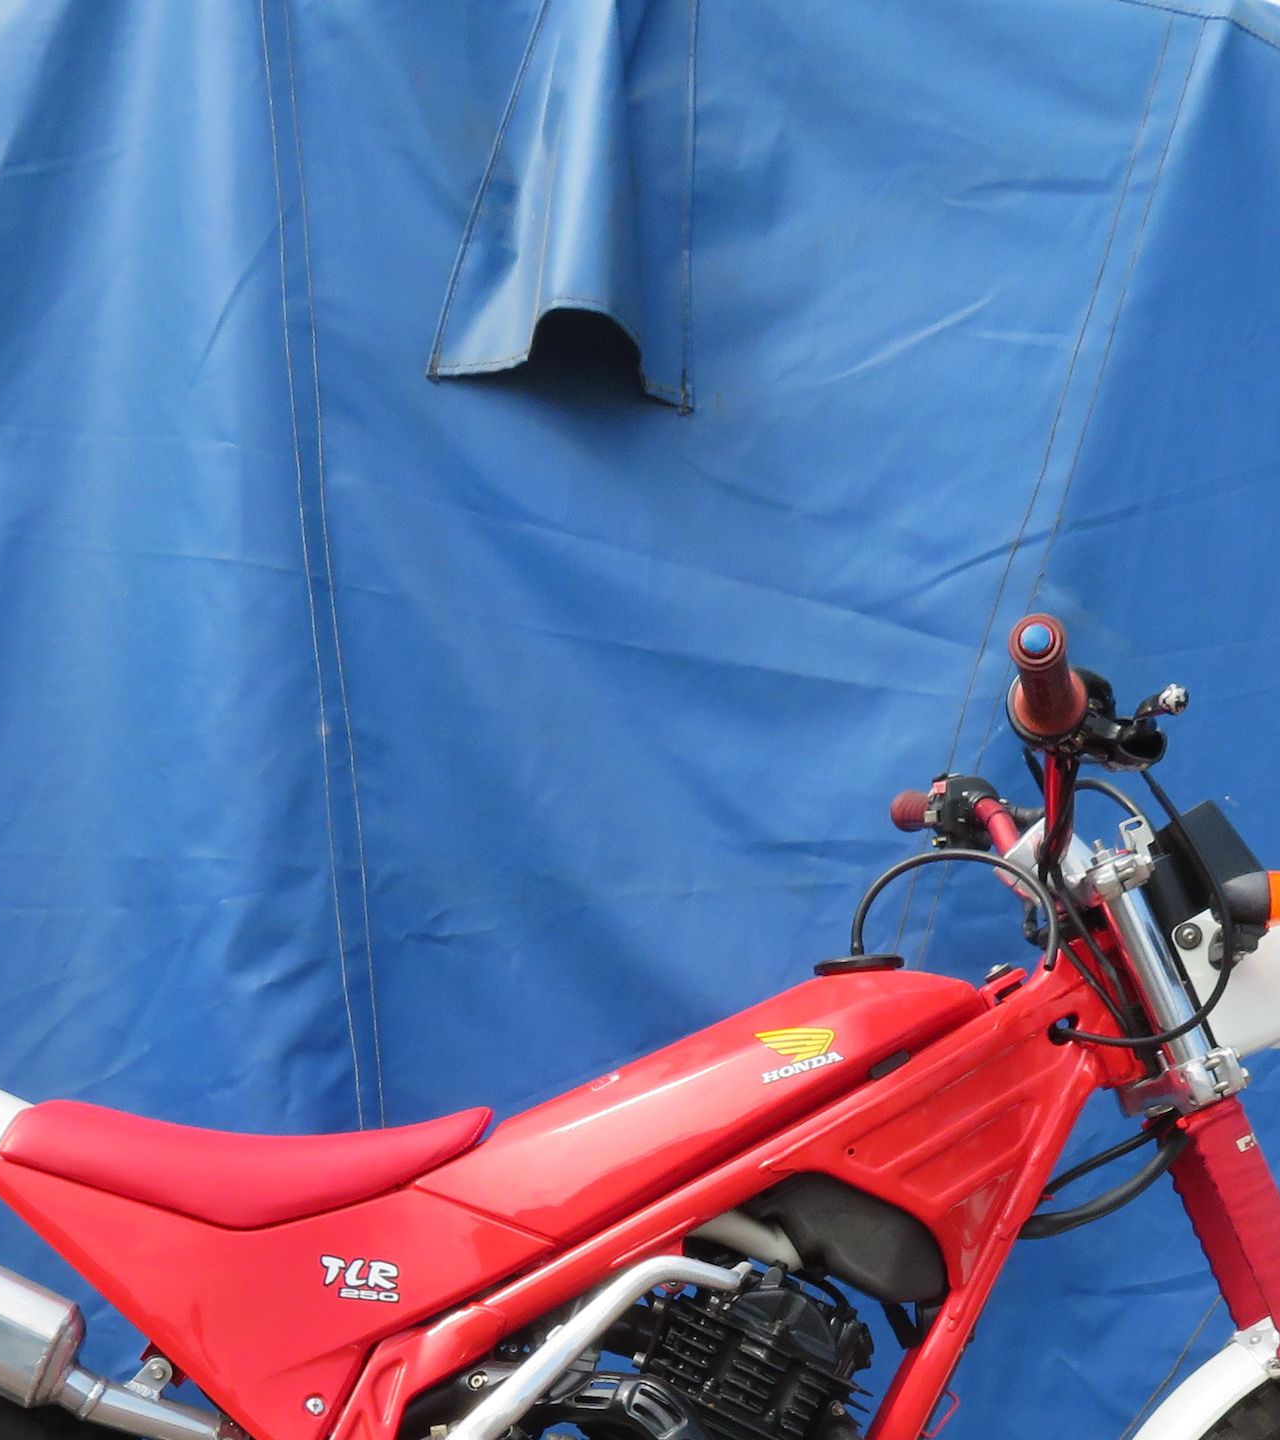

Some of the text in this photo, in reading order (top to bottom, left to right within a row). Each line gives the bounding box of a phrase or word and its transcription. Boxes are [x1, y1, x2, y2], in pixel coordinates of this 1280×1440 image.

[761, 1051, 845, 1084] HONDA
[320, 1254, 400, 1290] TLR
[337, 1287, 401, 1303] 250
